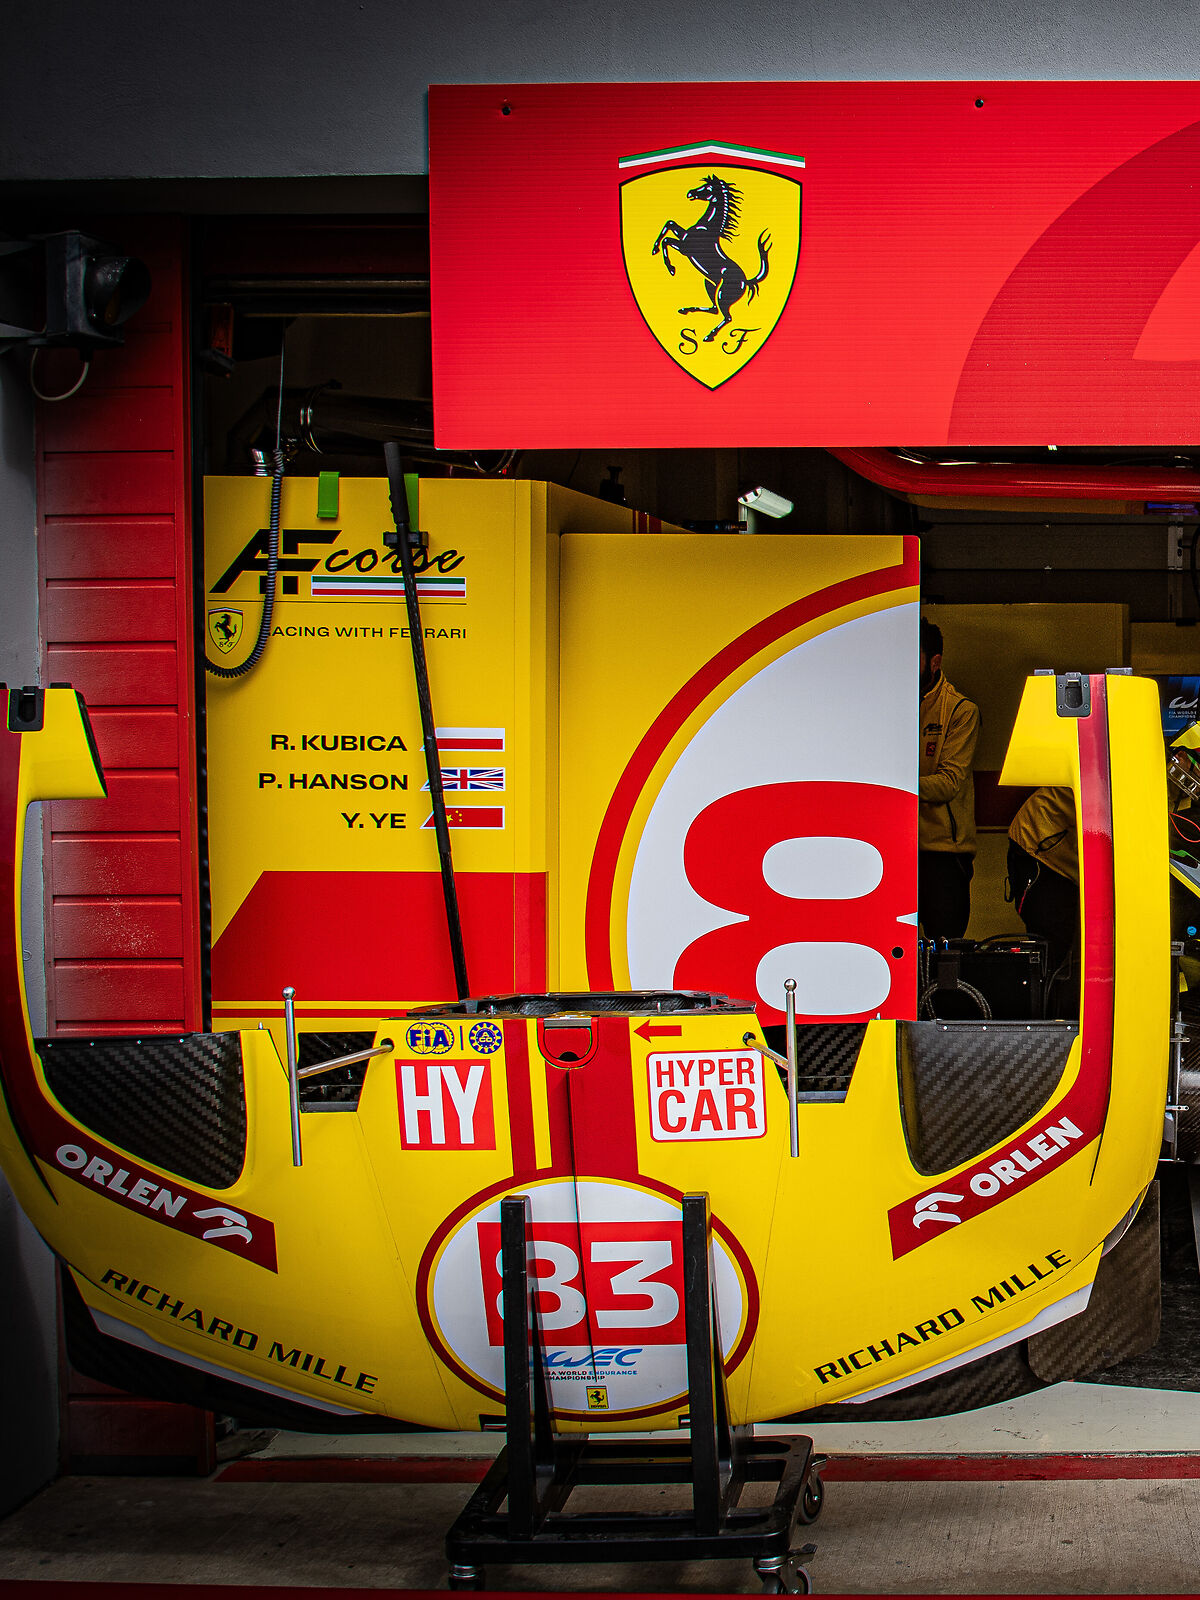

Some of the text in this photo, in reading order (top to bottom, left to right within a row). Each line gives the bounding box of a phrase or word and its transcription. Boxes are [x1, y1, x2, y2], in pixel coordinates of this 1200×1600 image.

[208, 528, 342, 595] AF
[268, 626, 467, 639] ACING WITH FERARI
[271, 734, 408, 751] R. KUBICA
[258, 773, 409, 790] P. HANSON
[341, 812, 407, 829] Y. YE
[400, 1065, 485, 1145] HY
[655, 1058, 755, 1088] HYPER
[657, 1087, 757, 1133] CAR
[56, 1144, 188, 1218] ORLEN
[969, 1116, 1084, 1197] ORLEN
[496, 1240, 679, 1330] 83
[813, 1249, 1072, 1385] RICHARD MILLE
[100, 1268, 379, 1394] RICHARD MILLE
